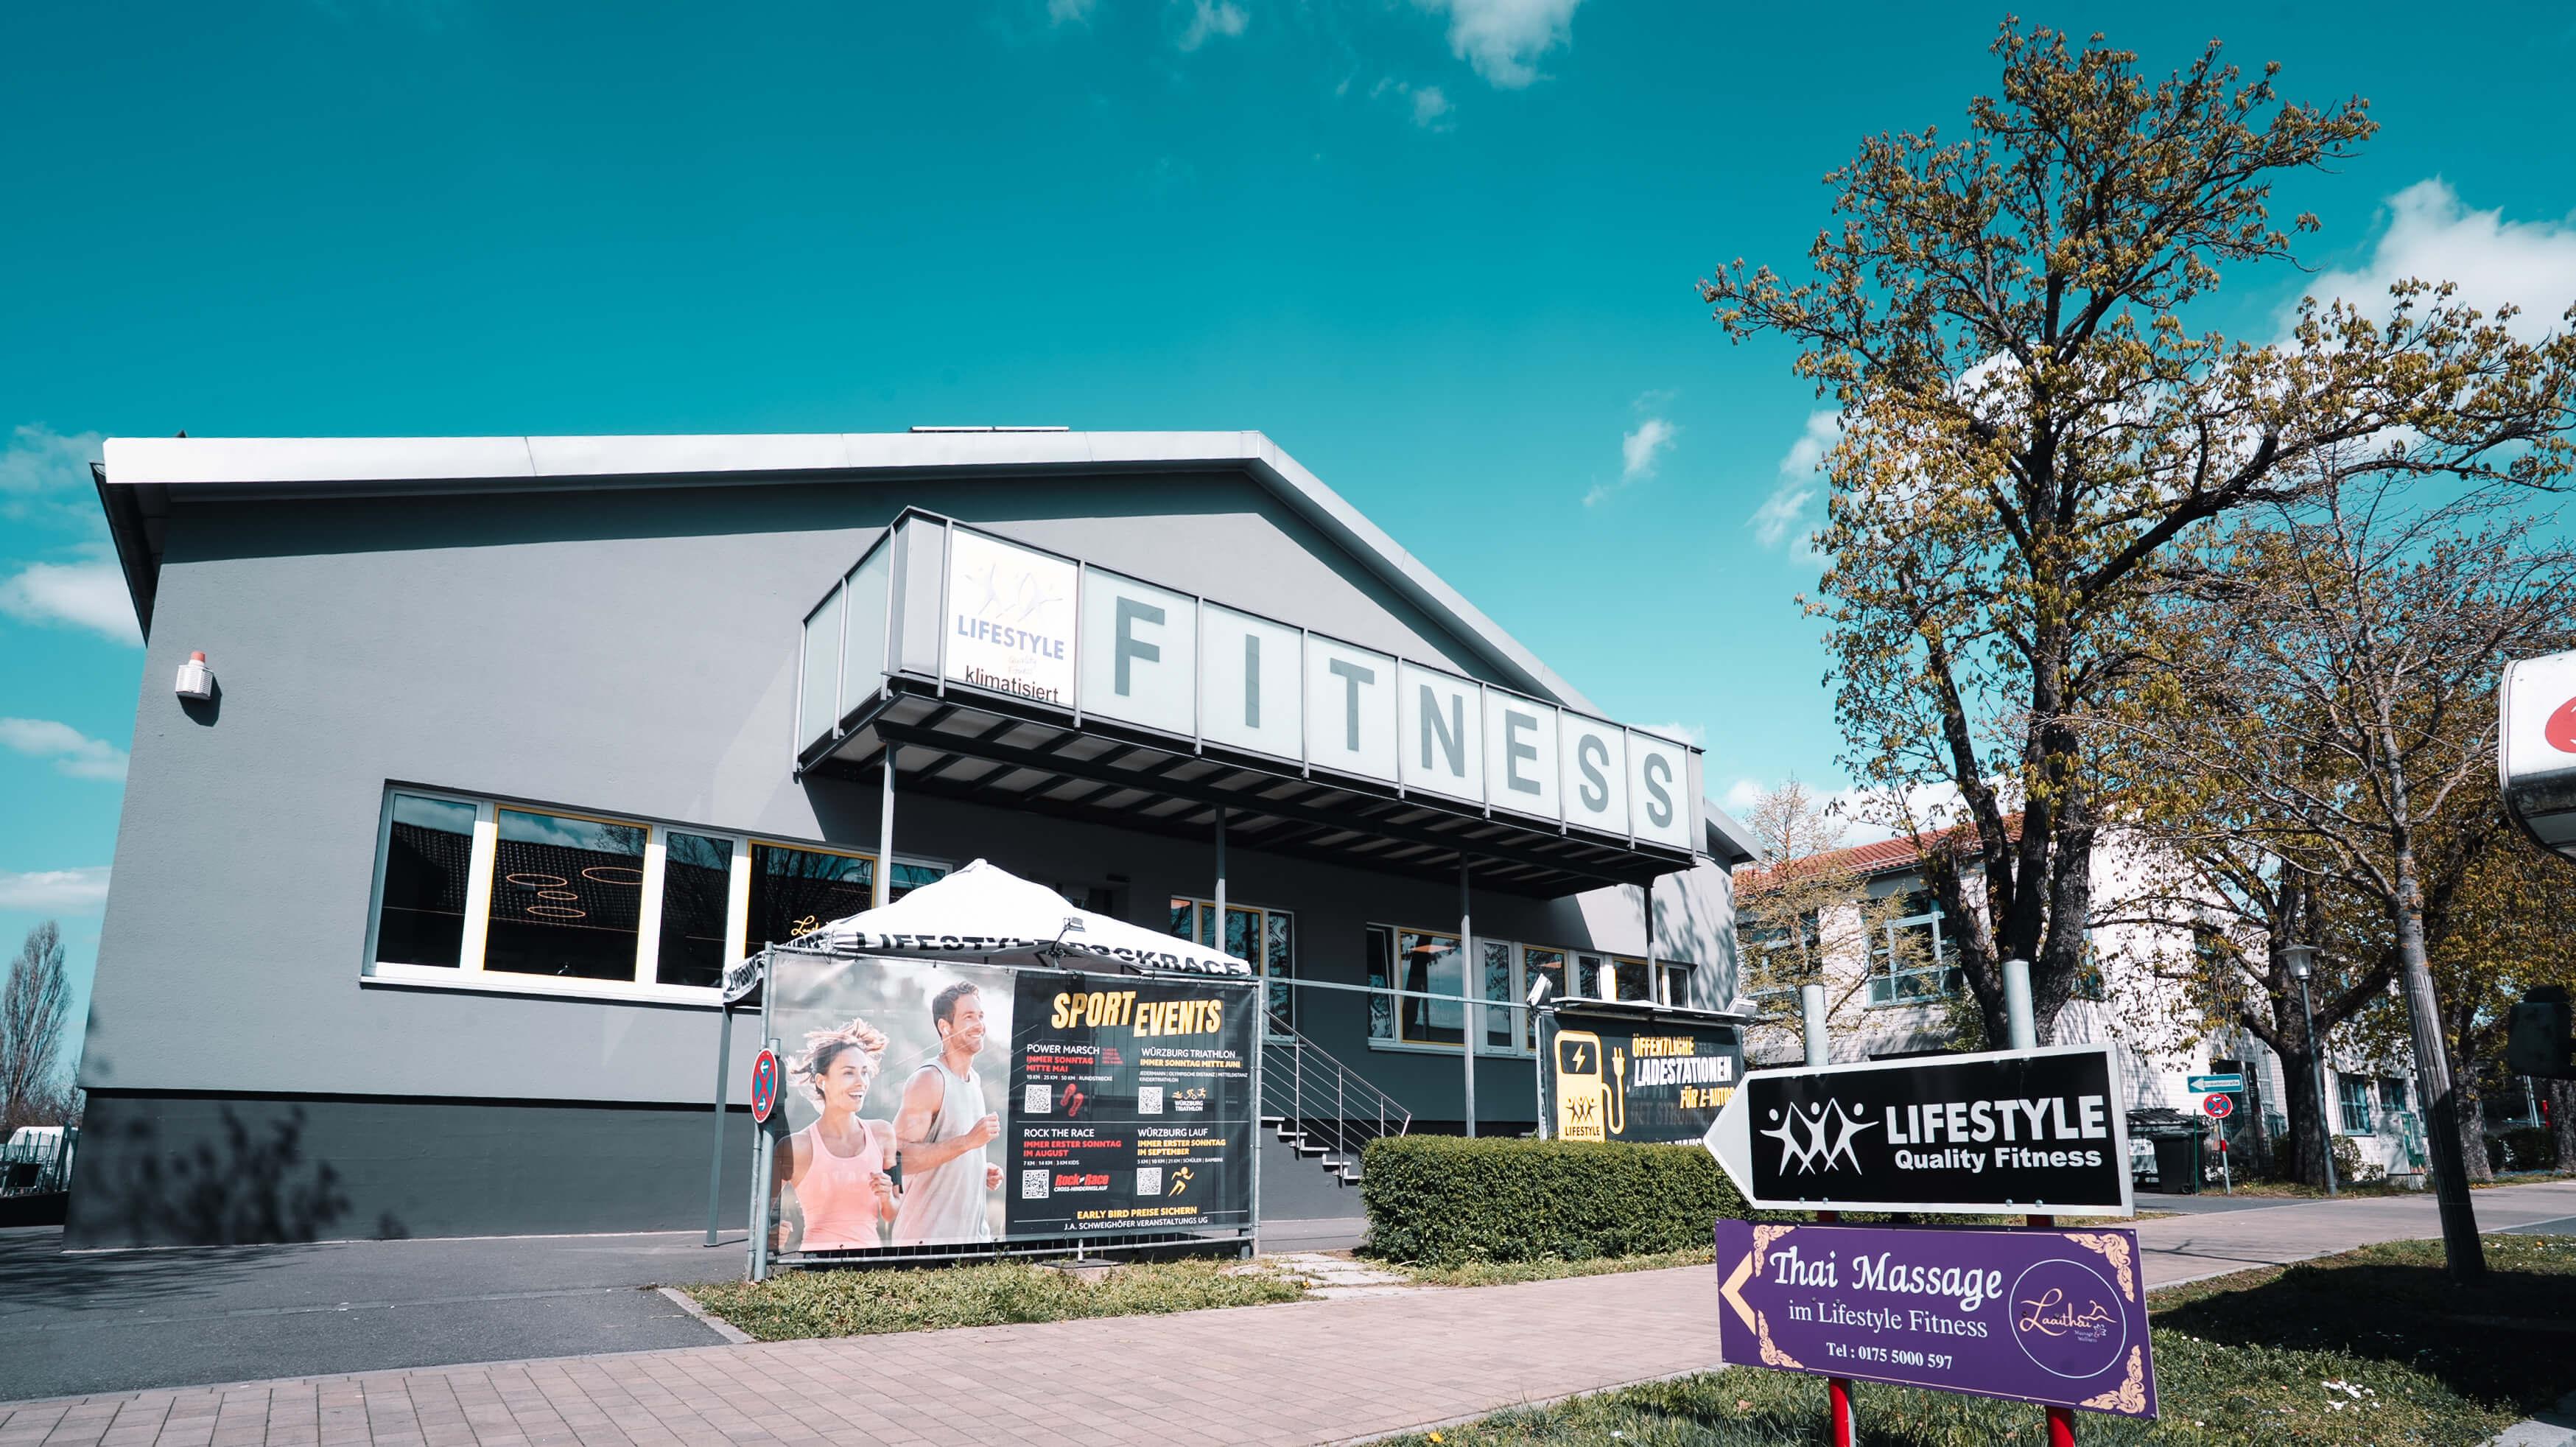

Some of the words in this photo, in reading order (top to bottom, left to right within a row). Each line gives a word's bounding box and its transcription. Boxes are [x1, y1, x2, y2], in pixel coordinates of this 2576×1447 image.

[958, 614, 1064, 661] LIFESTYLE
[965, 665, 1059, 704] klimatisiert
[1115, 595, 1673, 829] FITNESS
[1051, 991, 1137, 1029] SPORT
[1133, 999, 1222, 1037] EVENTS
[1027, 1043, 1061, 1054] POWER
[1063, 1045, 1100, 1055] MARSCH
[1632, 1033, 1694, 1057] ÖFFENTLICHE
[1142, 1047, 1188, 1057] WÜRZBURG
[1190, 1049, 1236, 1059] TRIATHLON
[1026, 1055, 1053, 1063] IMMER
[1054, 1057, 1094, 1065] SONNTAG
[1140, 1059, 1164, 1067] IMMER
[1165, 1059, 1201, 1068] SONNTAG
[1053, 1065, 1068, 1073] MAI
[1634, 1056, 1732, 1087] LADESTATIONEN
[1680, 1085, 1699, 1108] FÜR
[1886, 1095, 2107, 1145] LIFESTYLE
[1024, 1129, 1050, 1138] ROCK
[1051, 1129, 1069, 1138] THE
[1070, 1129, 1095, 1138] RACE
[1137, 1127, 1187, 1138] WÜRZBURG
[1188, 1128, 1209, 1137] LAUF
[1565, 1126, 1600, 1136] LIFESTYLE
[1051, 1141, 1081, 1149] ERSTER
[1036, 1149, 1070, 1157] AUGUST
[1148, 1148, 1190, 1156] SEPTEMBER
[1894, 1149, 1986, 1174] Quality
[1995, 1147, 2102, 1169] Fitness
[1077, 1210, 1106, 1219] EARLY
[1107, 1210, 1129, 1218] BIRD
[1131, 1208, 1159, 1217] PREISE
[1160, 1206, 1198, 1215] SICHERN
[1078, 1220, 1135, 1230] SCHWEIGHÖFER
[1137, 1218, 1197, 1227] VERANSTALTUNGS
[1769, 1245, 1839, 1288] Thai
[1851, 1252, 2003, 1312] Massage
[1789, 1300, 1811, 1321] im
[1817, 1301, 1902, 1334] Lifestyle
[1909, 1309, 1988, 1338] Fitness
[1826, 1342, 1847, 1357] Tel
[1858, 1345, 1888, 1362] 0175
[1891, 1349, 1924, 1367] 5000
[1927, 1353, 1953, 1370] 597
